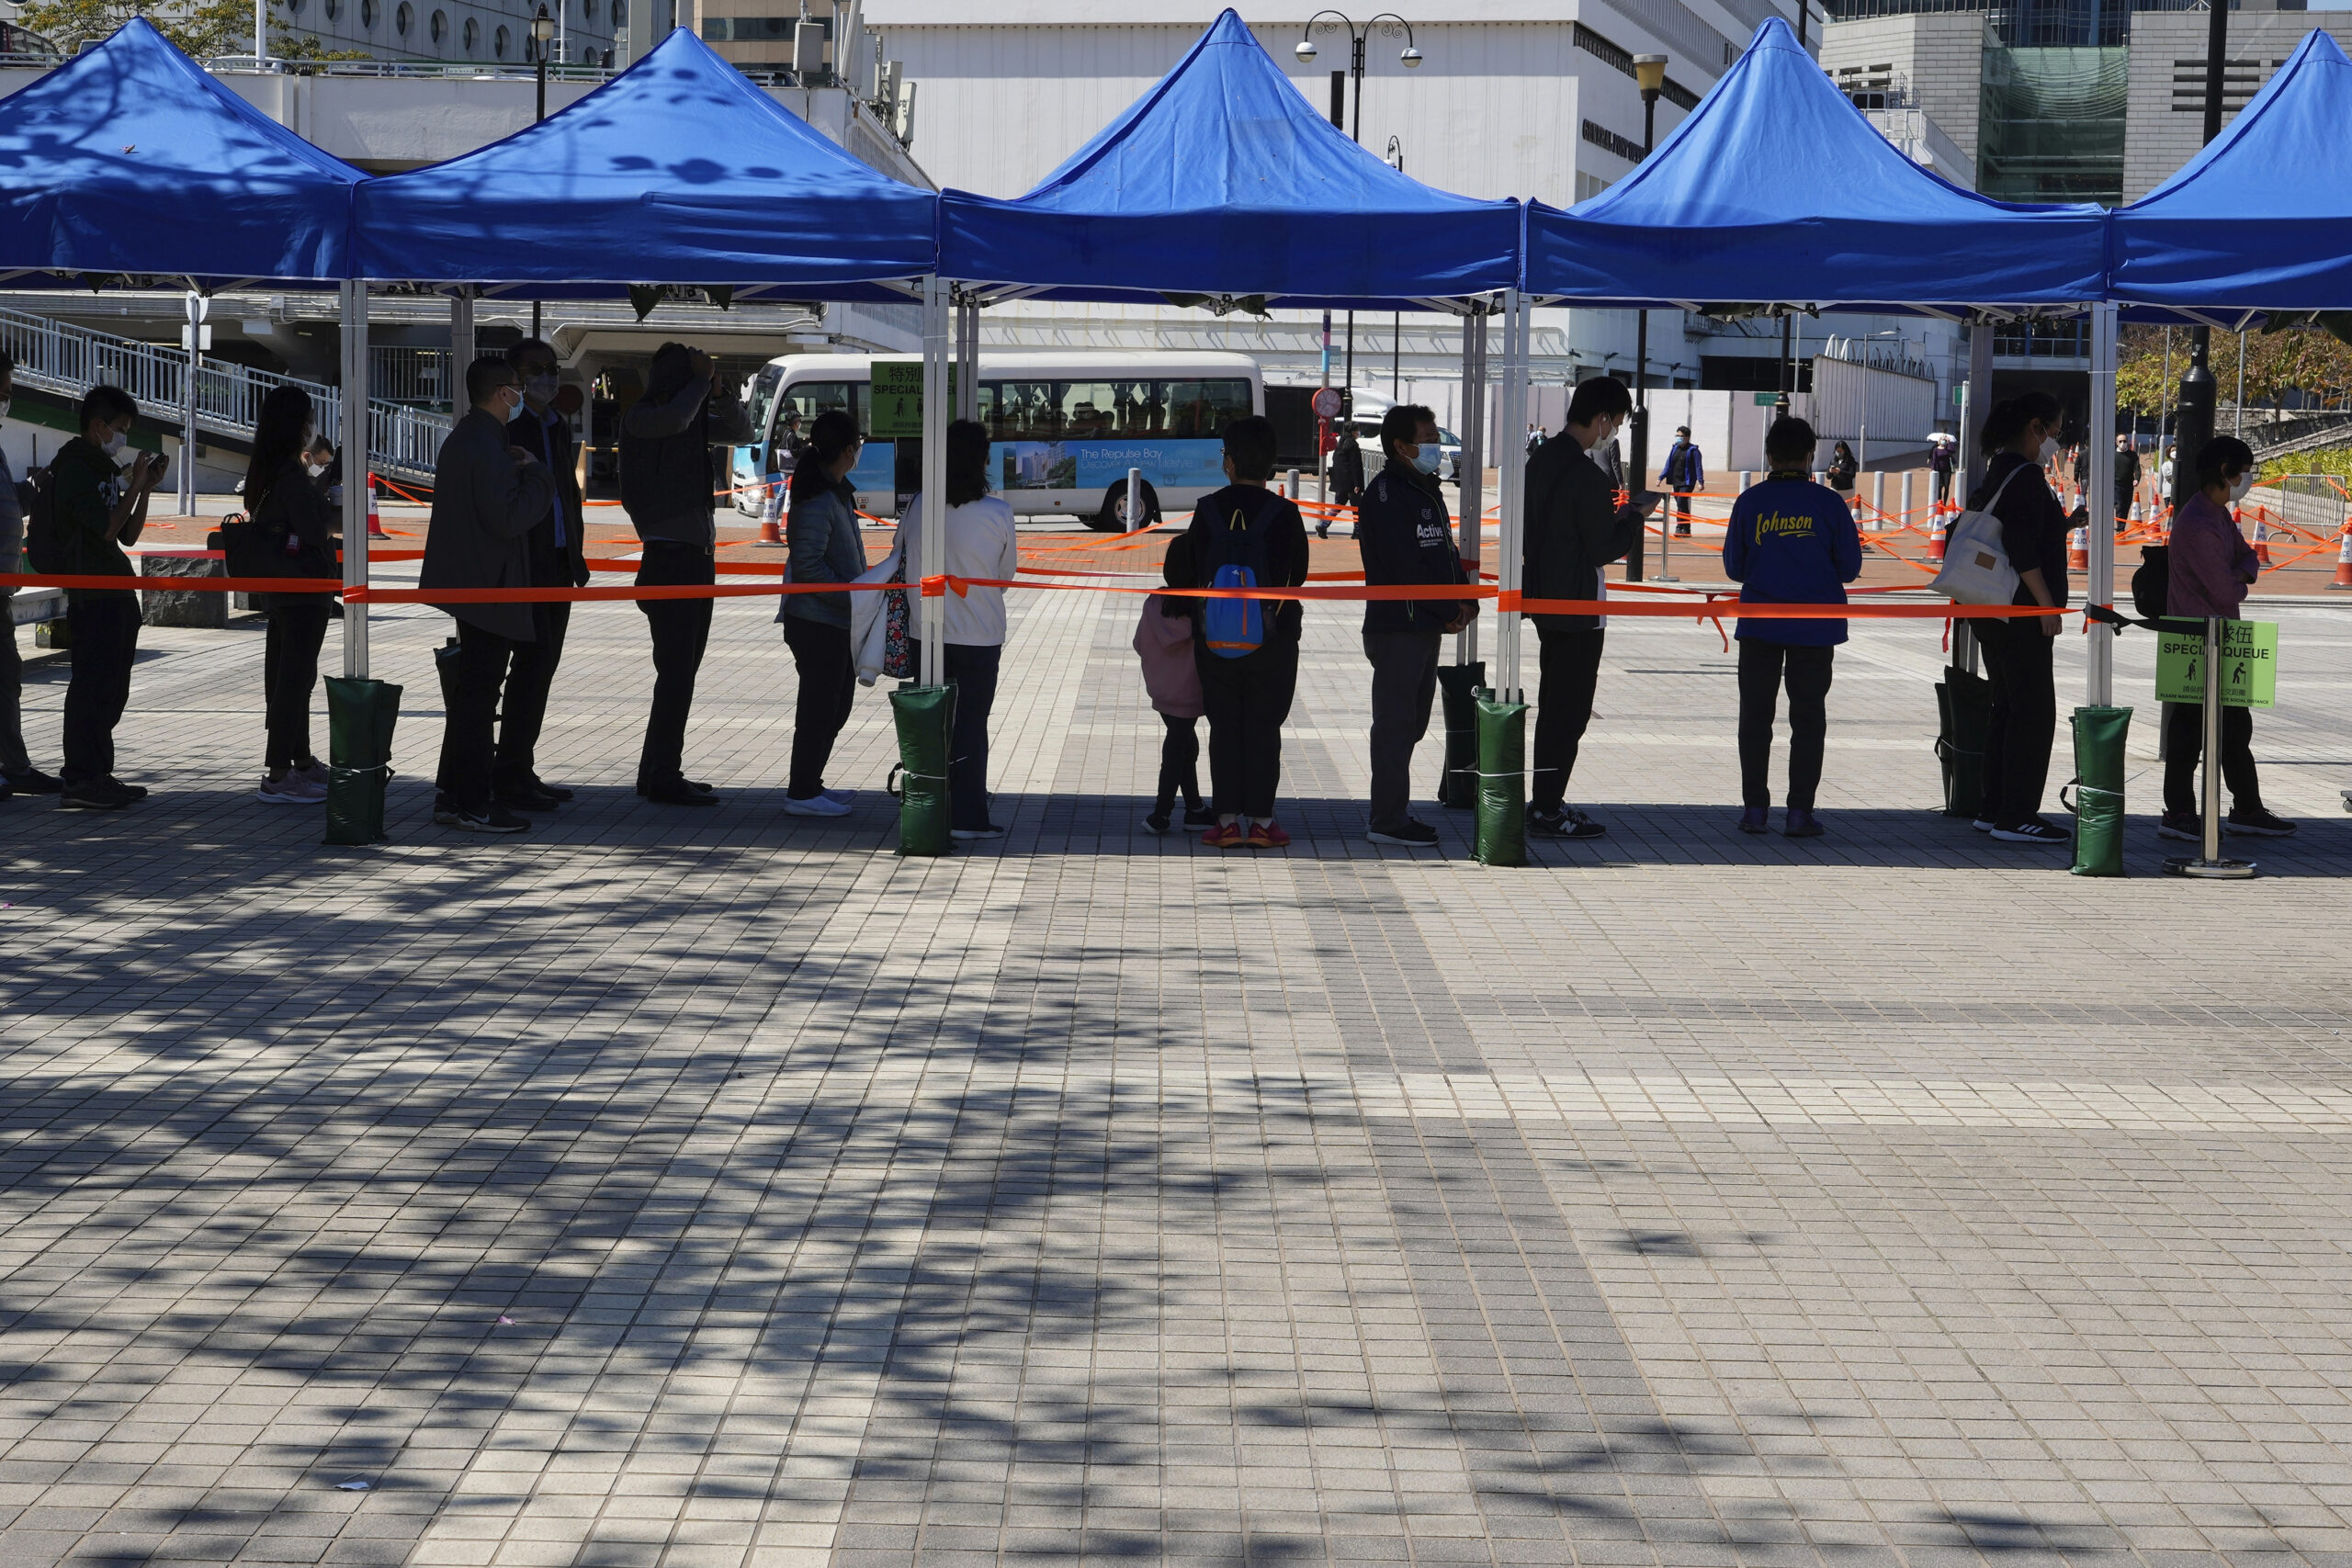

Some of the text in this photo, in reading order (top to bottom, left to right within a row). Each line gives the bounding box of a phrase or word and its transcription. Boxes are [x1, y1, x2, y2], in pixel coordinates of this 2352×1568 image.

[874, 385, 923, 395] SPECIAL
[1081, 447, 1162, 460] The Repulse Bay
[1080, 458, 1121, 469] Discover
[1416, 524, 1444, 538] Active
[1755, 510, 1813, 546] Johnson
[2223, 646, 2269, 660] QUEUE
